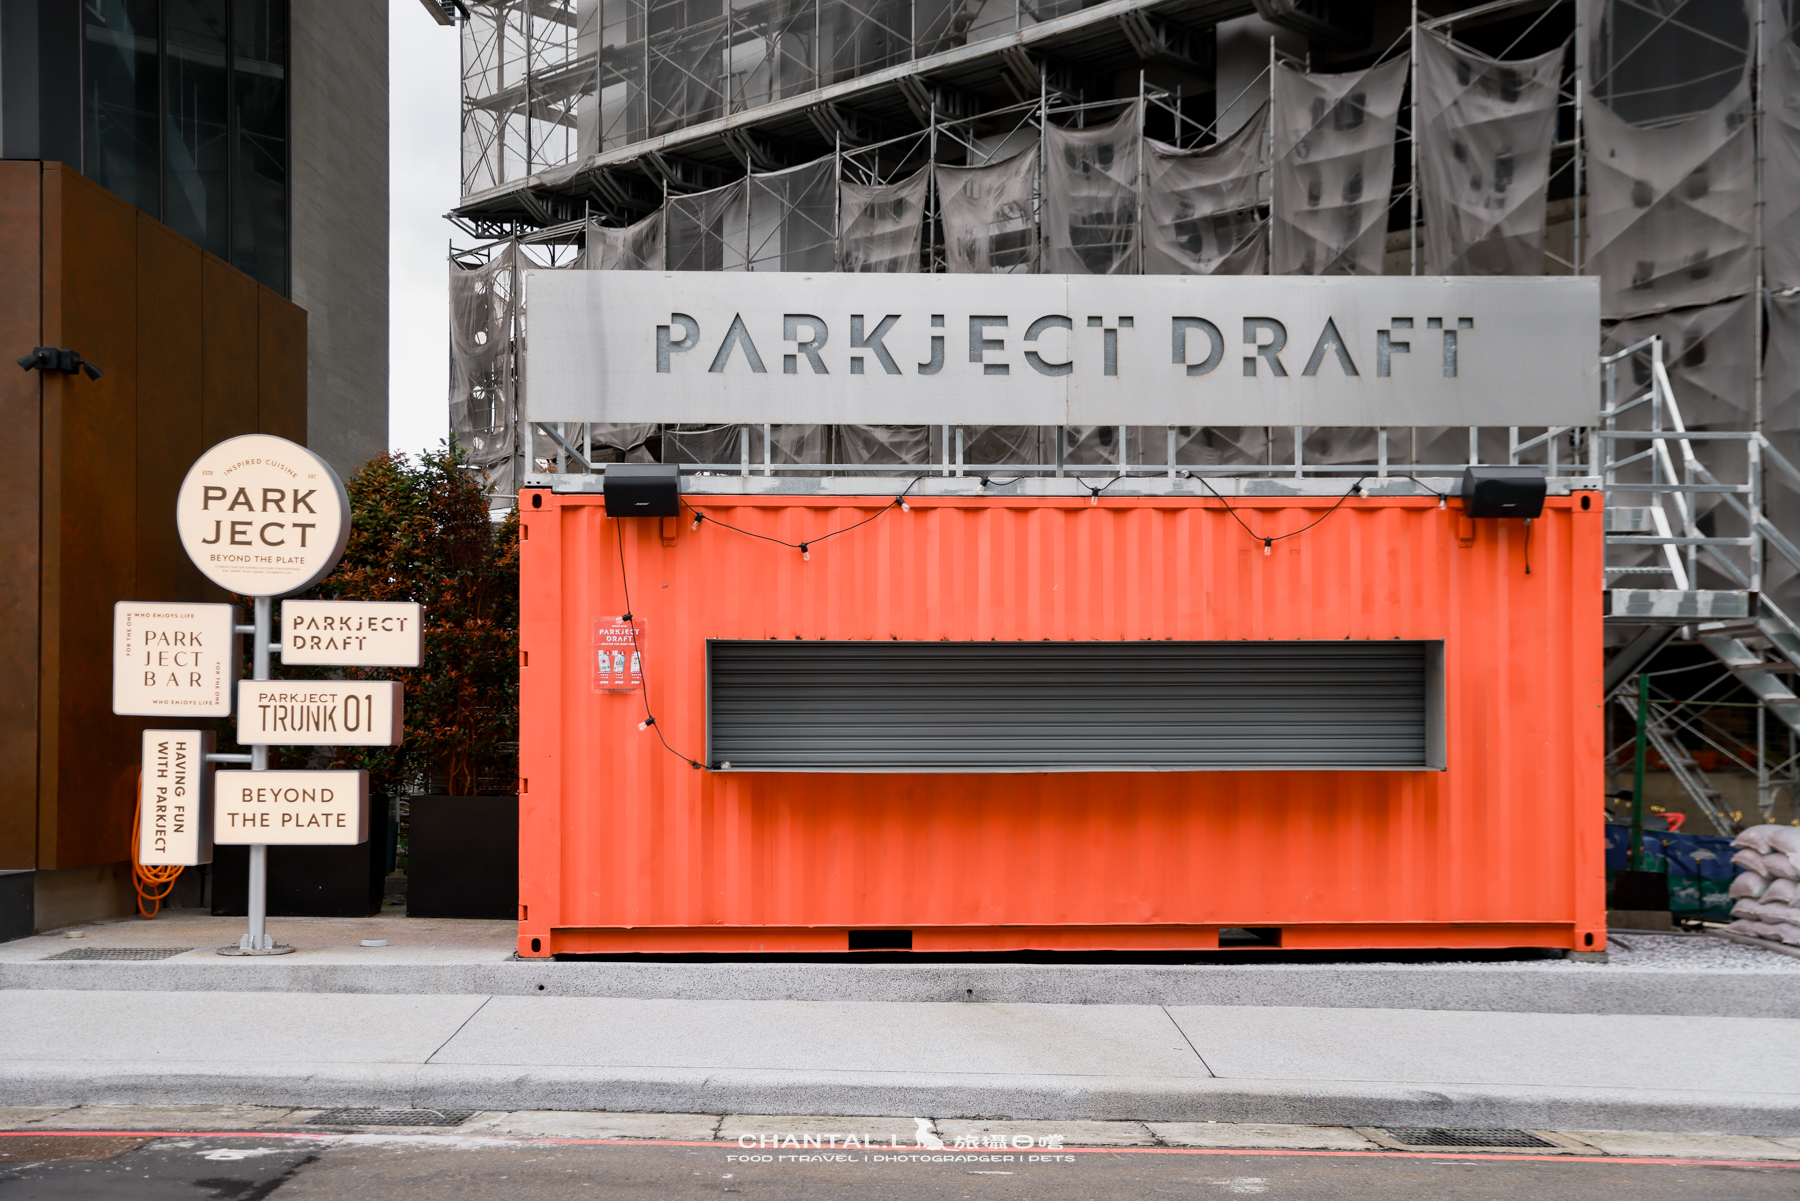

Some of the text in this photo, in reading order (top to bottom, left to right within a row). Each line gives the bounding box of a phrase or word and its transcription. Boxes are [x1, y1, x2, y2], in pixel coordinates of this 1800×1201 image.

[656, 312, 1474, 378] PARKJECT DRAFT
[223, 458, 298, 479] INSPIRED CUISINE
[201, 485, 318, 514] PARK
[201, 520, 317, 548] JECT
[210, 554, 305, 564] BEYOND THE PLATE
[293, 615, 408, 632] PARKJECT
[145, 630, 203, 647] PARK
[293, 635, 367, 651] DRAFT
[144, 651, 203, 667] JECT
[144, 671, 202, 687] BAR
[259, 693, 338, 703] PARKJECT
[258, 694, 372, 732] TRUNK 01
[173, 742, 187, 833] HAVING FUN
[242, 788, 334, 803] BEYOND
[155, 741, 169, 854] WITH PARKJECT
[227, 812, 346, 828] THE PLATE
